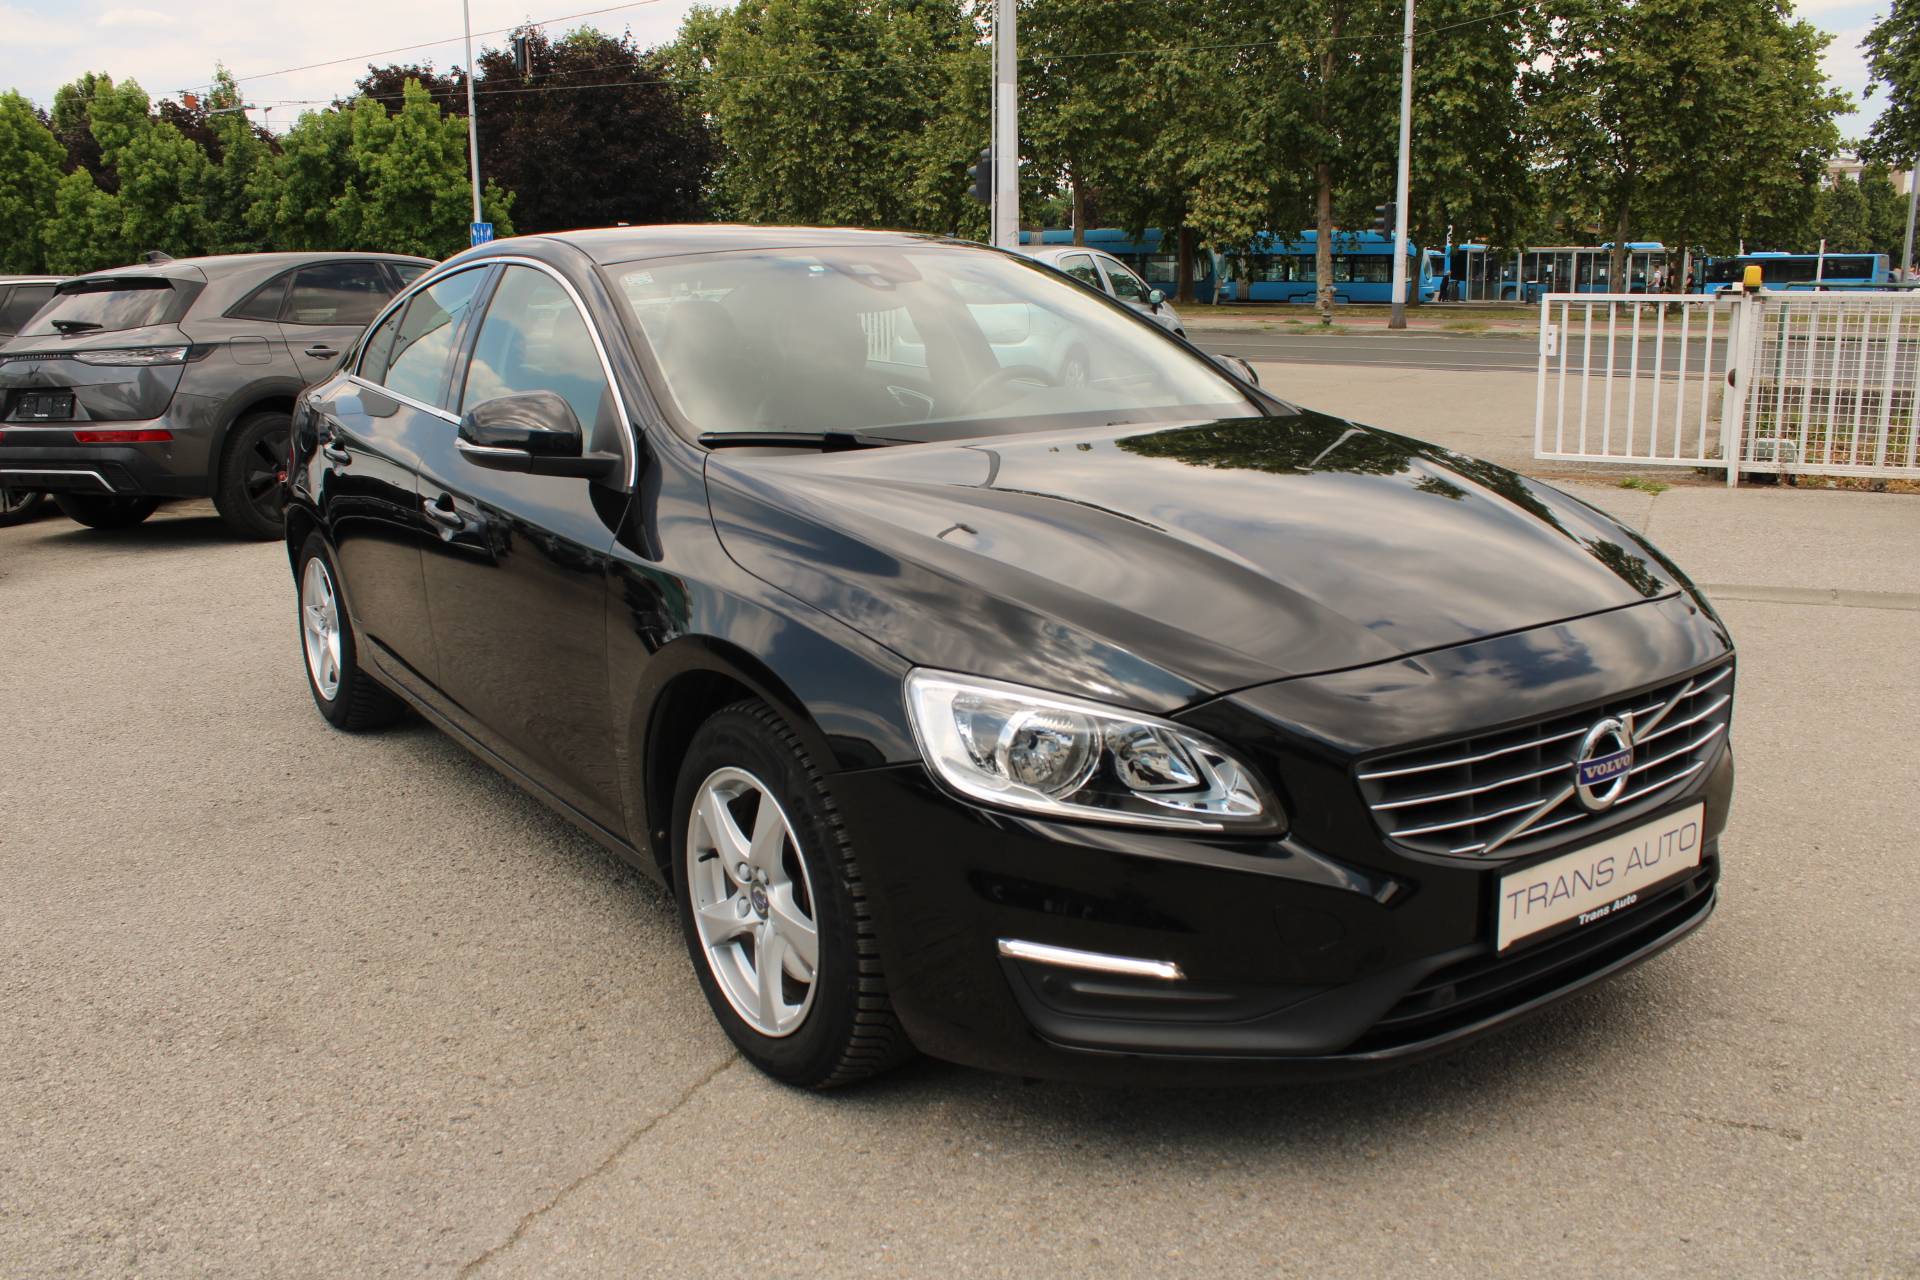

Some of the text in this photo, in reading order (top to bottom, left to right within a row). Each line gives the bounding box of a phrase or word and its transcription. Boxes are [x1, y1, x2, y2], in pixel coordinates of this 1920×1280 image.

[1584, 754, 1631, 779] VOLVO
[1506, 822, 1697, 920] TRANS AUTO
[1579, 894, 1638, 925] Trans Auto
